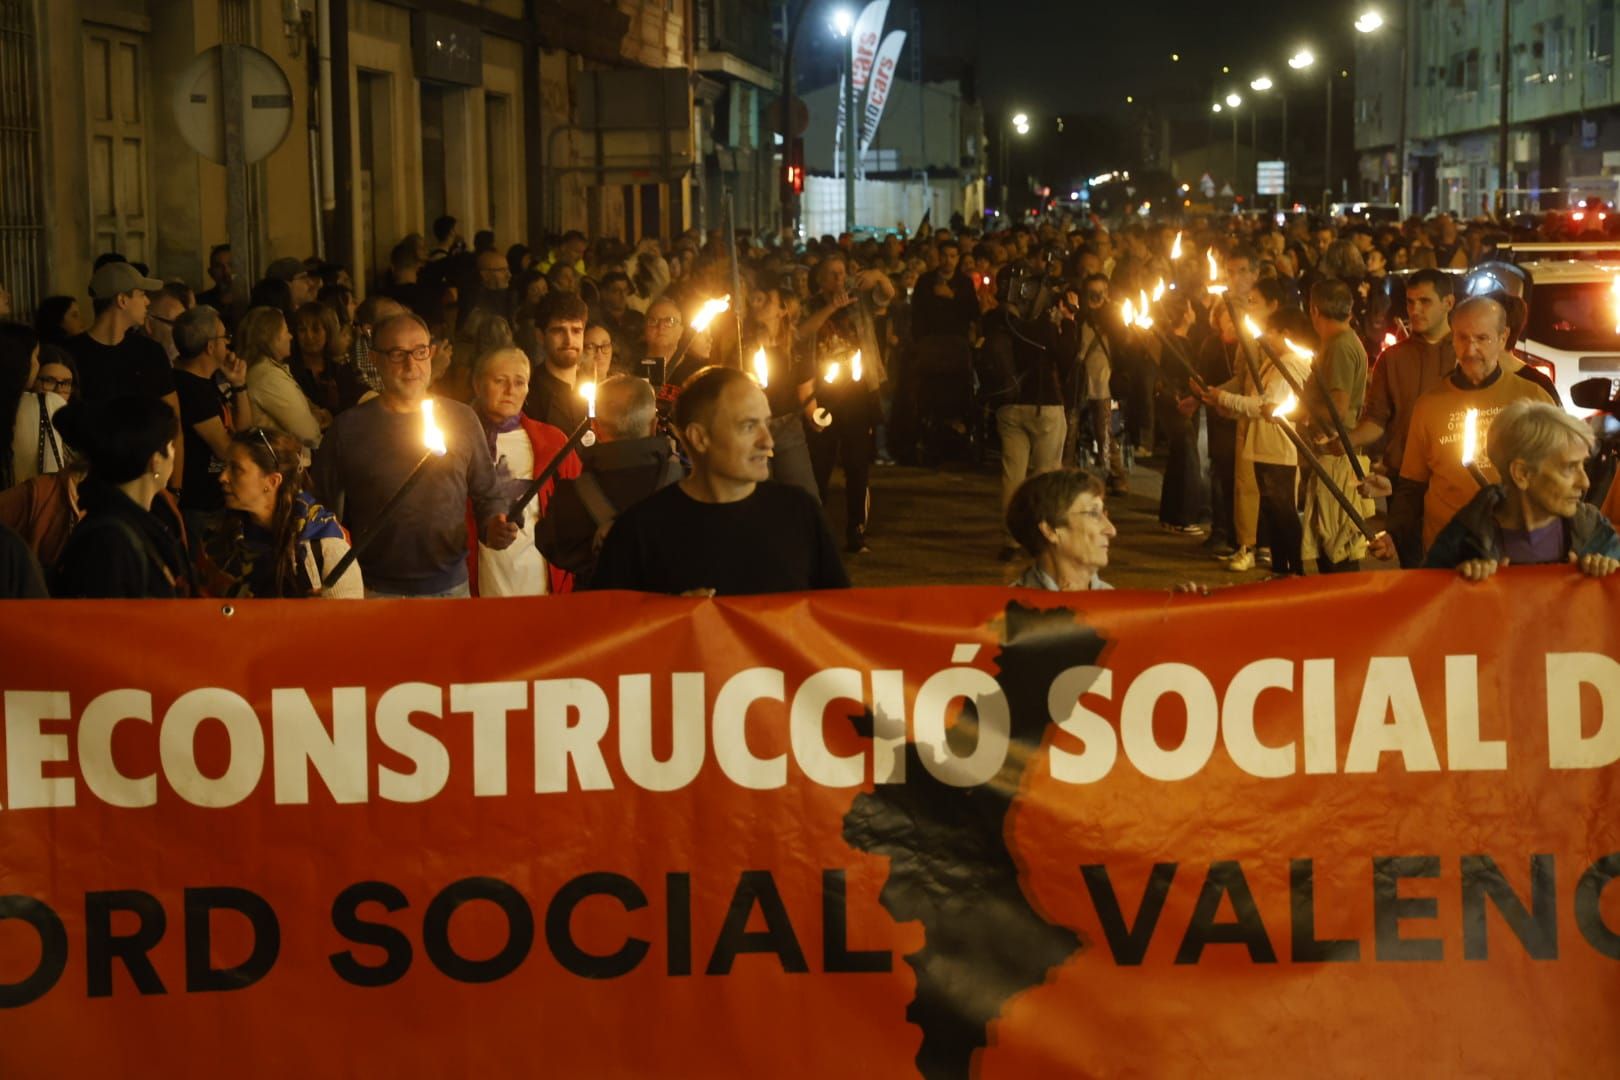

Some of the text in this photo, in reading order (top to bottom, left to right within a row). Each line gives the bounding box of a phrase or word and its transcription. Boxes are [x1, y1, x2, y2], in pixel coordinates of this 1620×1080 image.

[0, 643, 1011, 810] ECONSTRUCCIÓ
[1047, 654, 1508, 784] SOCIAL
[328, 868, 893, 988] SOCIAL
